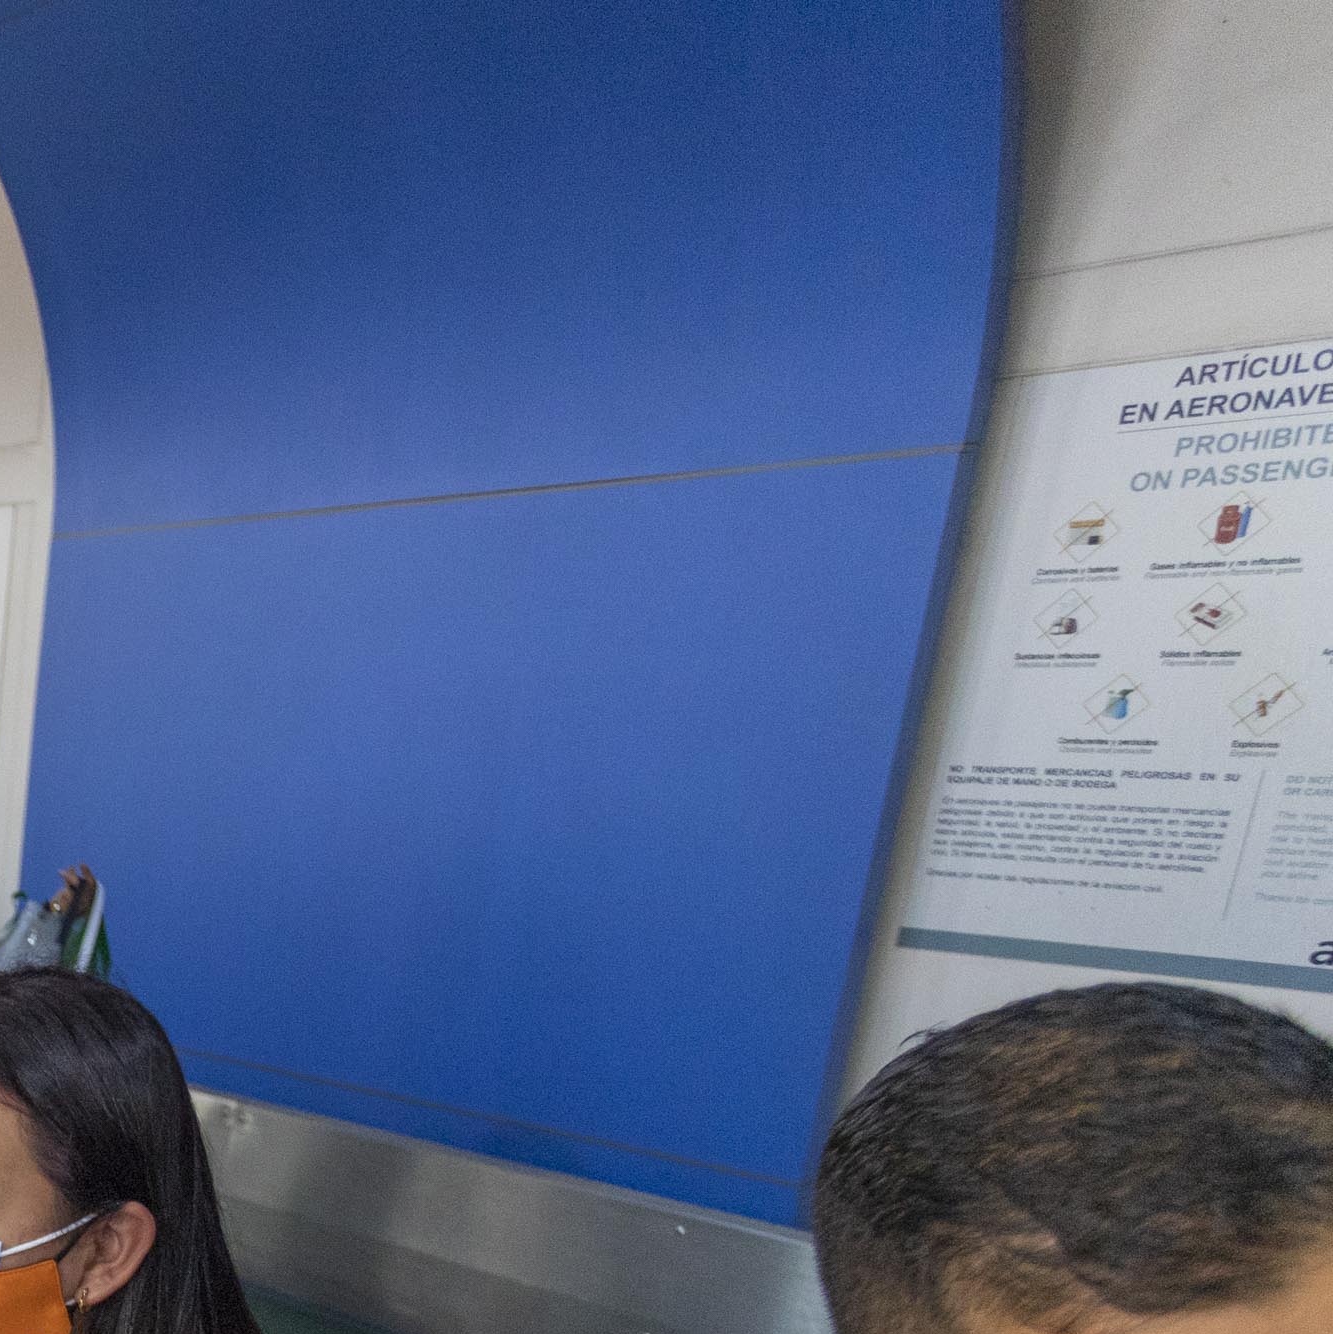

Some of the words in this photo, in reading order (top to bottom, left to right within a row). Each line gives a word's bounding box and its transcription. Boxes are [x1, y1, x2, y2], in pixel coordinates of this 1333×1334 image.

[1119, 402, 1158, 425] EN
[1164, 383, 1333, 420] AERONAVE
[1130, 470, 1172, 492] ON
[1181, 456, 1333, 488] PASSENG
